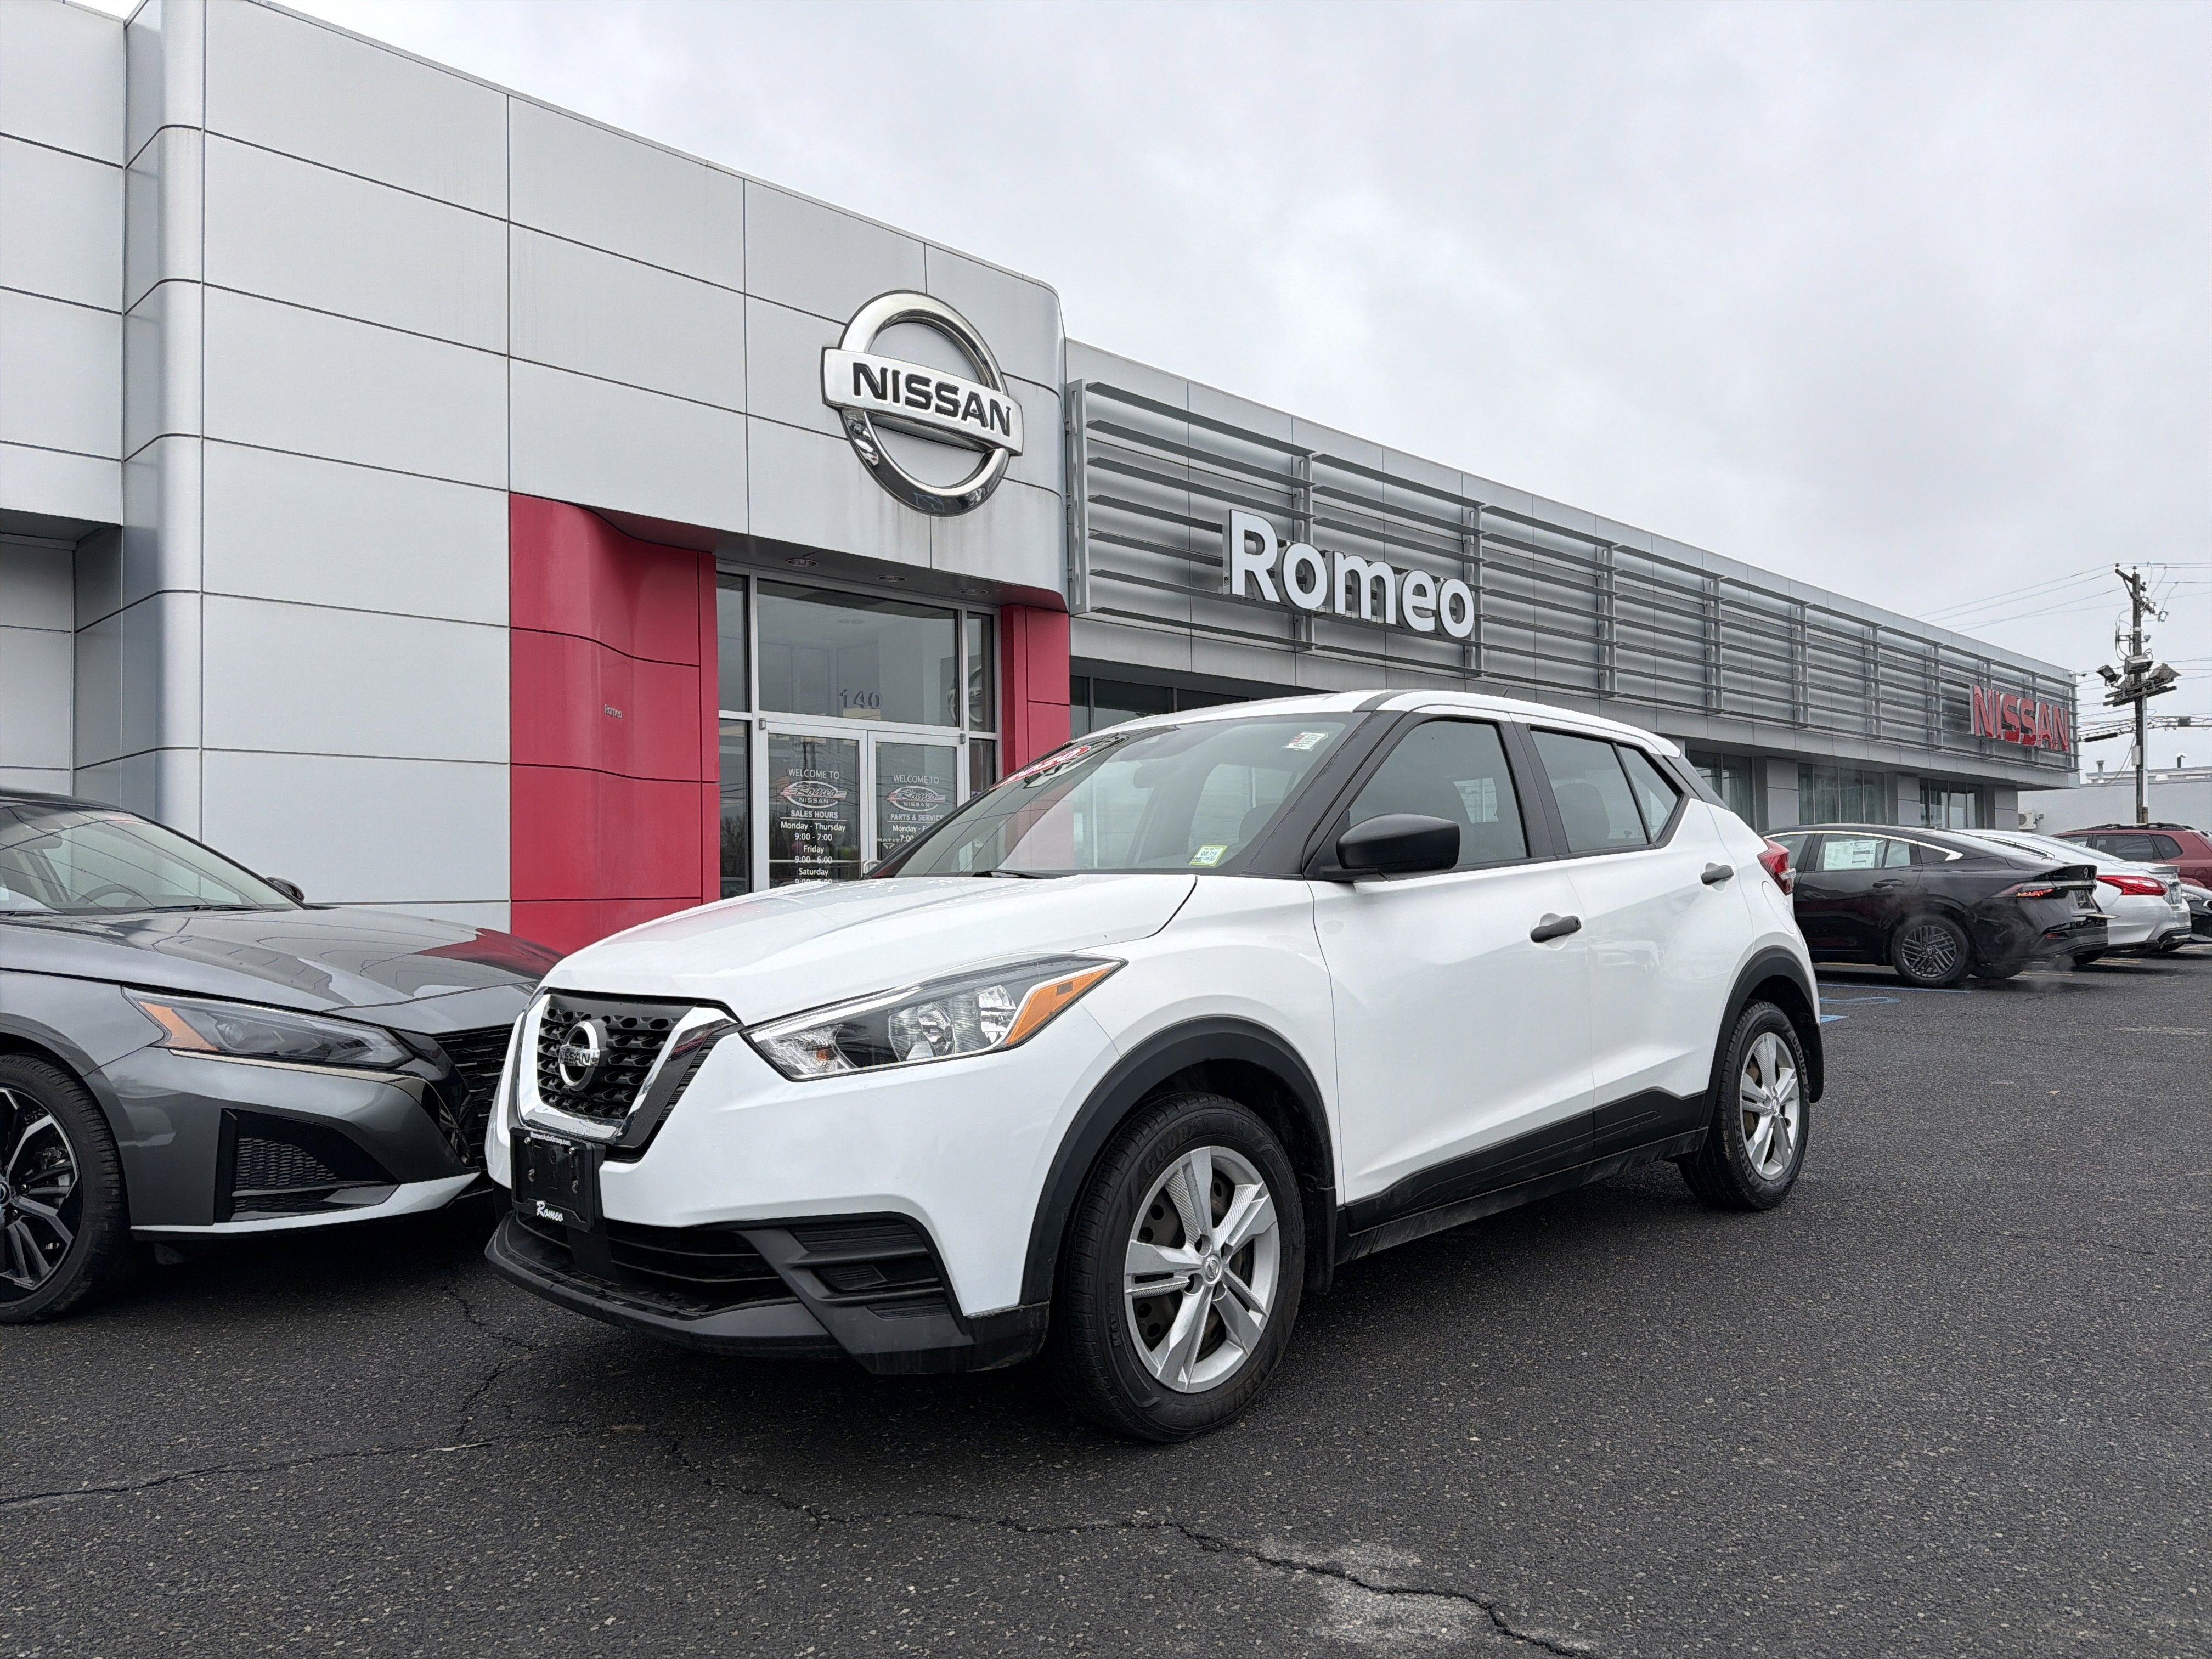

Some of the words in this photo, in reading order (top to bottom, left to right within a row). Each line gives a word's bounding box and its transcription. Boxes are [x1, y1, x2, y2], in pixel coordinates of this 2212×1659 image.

[853, 362, 1011, 437] NISSAN
[1228, 509, 1475, 638] Romeo
[840, 689, 881, 709] 140
[605, 704, 622, 719] Romeo
[1971, 685, 2070, 752] NISSAN
[788, 768, 827, 778] WELCOME
[893, 775, 928, 783] WELCOME
[795, 782, 837, 797] Romeo
[900, 788, 936, 800] Romeo
[781, 821, 808, 831] Monday
[815, 823, 846, 832] Thursday
[893, 825, 917, 833] Monday
[803, 845, 824, 854] Friday
[799, 868, 829, 877] Saturday
[537, 1200, 563, 1222] Romeo
